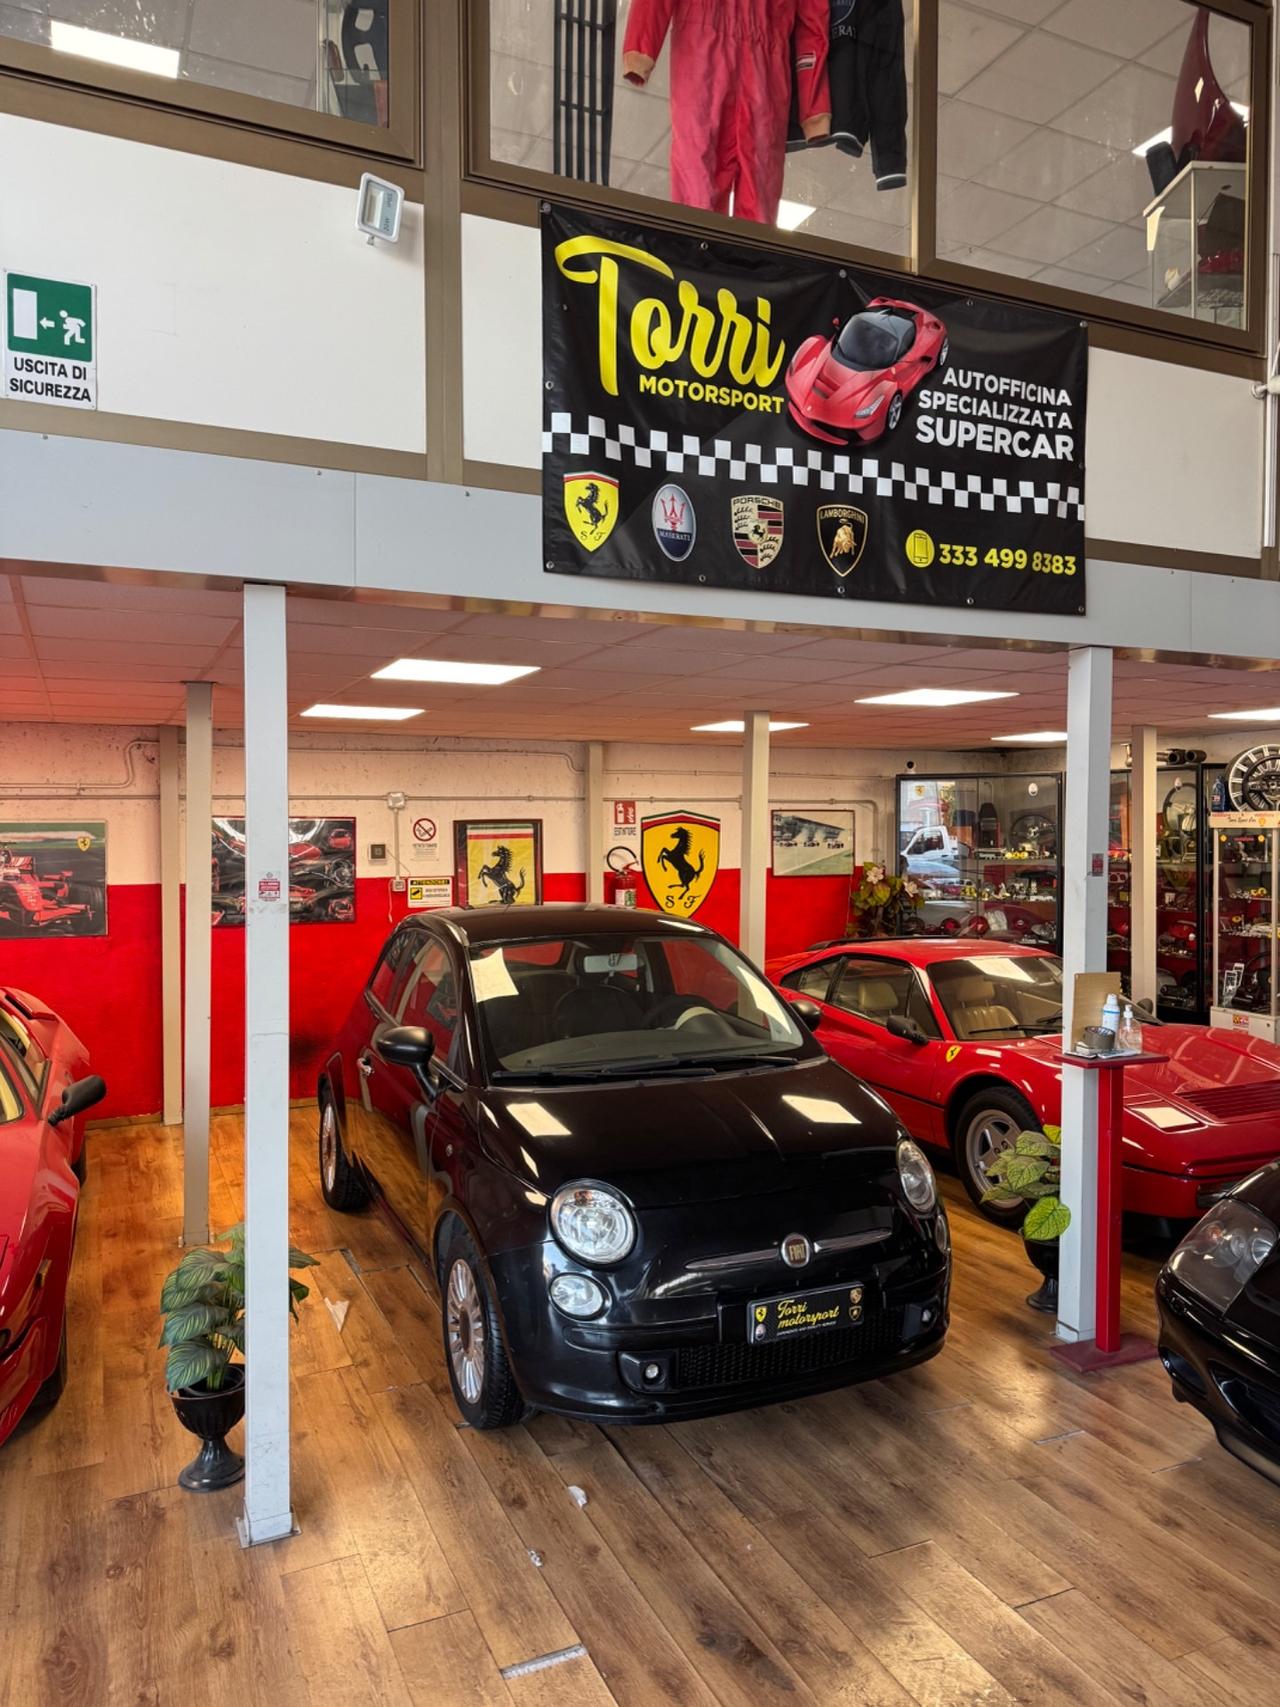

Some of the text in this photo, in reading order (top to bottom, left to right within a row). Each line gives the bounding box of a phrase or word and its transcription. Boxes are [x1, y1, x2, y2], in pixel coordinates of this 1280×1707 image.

[554, 235, 786, 396] Torri
[13, 357, 87, 380] USCITA DI
[9, 378, 92, 402] SICUREZZA
[639, 374, 784, 413] MOTORSPORT
[942, 367, 1072, 407] AUTOFFICINA
[918, 390, 1073, 430] SPECIALIZZATA
[915, 415, 1074, 461] SUPERCAR
[732, 495, 782, 508] PORSCHE
[820, 508, 865, 523] LAMBORGHINI
[939, 543, 1076, 575] 333 499 8383
[788, 1243, 806, 1261] FIAT
[777, 1299, 808, 1319] Torri
[777, 1306, 840, 1329] motorsport
